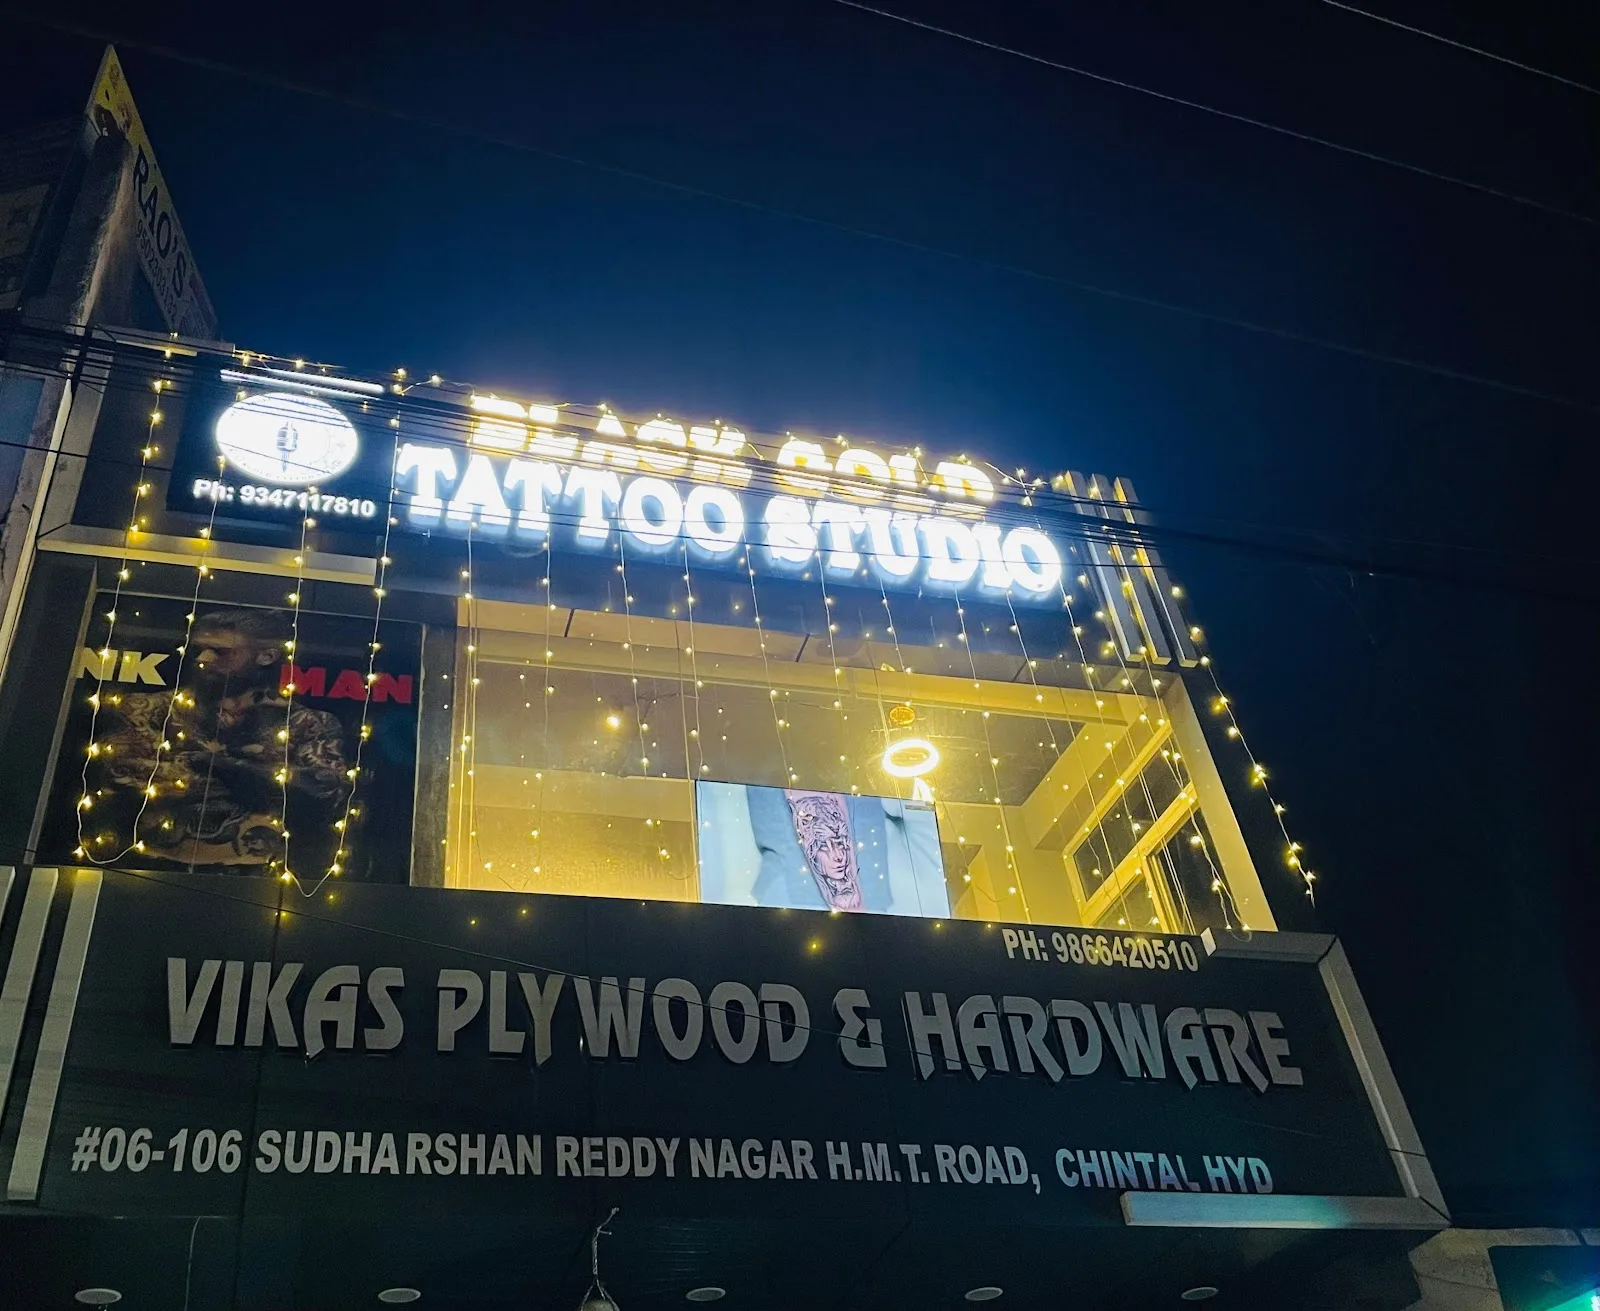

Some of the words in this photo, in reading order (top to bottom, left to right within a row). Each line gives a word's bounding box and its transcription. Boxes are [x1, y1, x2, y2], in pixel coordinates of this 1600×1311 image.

[133, 144, 187, 299] RAO'S
[193, 478, 235, 501] Ph:
[239, 484, 377, 518] 9347117810
[396, 443, 745, 552] TATTOO
[764, 495, 1062, 593] STUDIO
[279, 663, 413, 704] MAN
[1002, 928, 1049, 962] PH:
[1052, 932, 1199, 972] 9866420510
[166, 957, 406, 1059] VIKAS
[436, 968, 811, 1066] PLYWOOD
[832, 987, 888, 1069] &
[901, 990, 1304, 1094] HARDWARE
[71, 1126, 242, 1173] #06-106
[556, 1133, 681, 1178] REDDY
[689, 1137, 819, 1180] NAGAR
[933, 1144, 1042, 1195] ROAD,
[1055, 1148, 1201, 1192] CHINTAL
[1202, 1155, 1274, 1194] HYD
